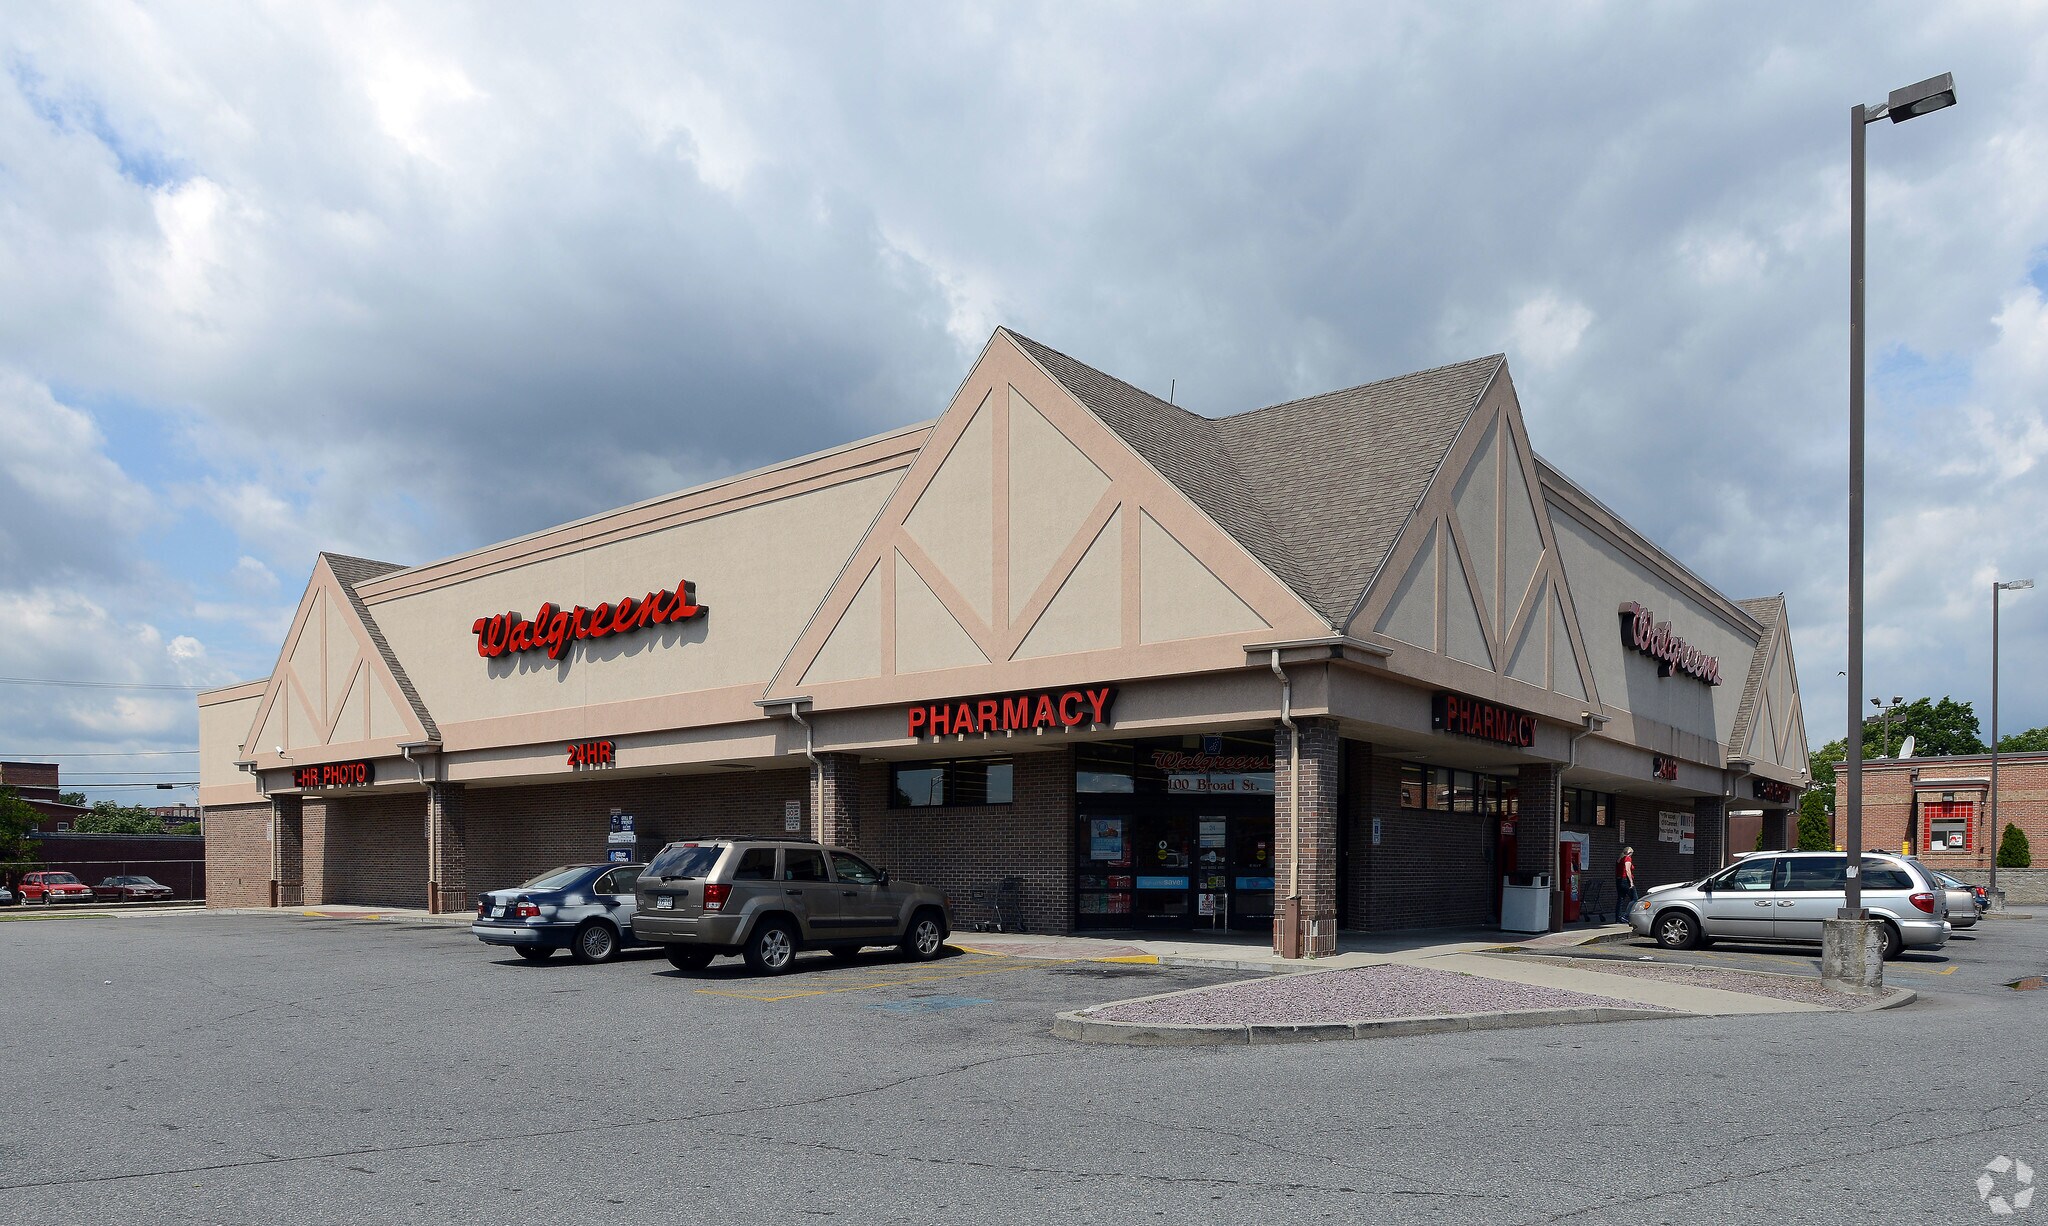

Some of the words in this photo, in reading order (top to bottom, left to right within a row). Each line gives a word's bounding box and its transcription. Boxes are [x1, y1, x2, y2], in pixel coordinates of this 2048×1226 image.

[472, 579, 702, 660] Walgreens
[1627, 601, 1722, 686] Walgreens
[908, 688, 1110, 737] PHARMACY
[1447, 696, 1538, 746] PHARMACY
[567, 741, 611, 765] 24HR
[1152, 752, 1274, 772] Walgreens
[323, 763, 366, 784] PHOTO
[1168, 779, 1189, 790] 100
[1197, 778, 1235, 791] Broad
[1242, 779, 1260, 791] St.
